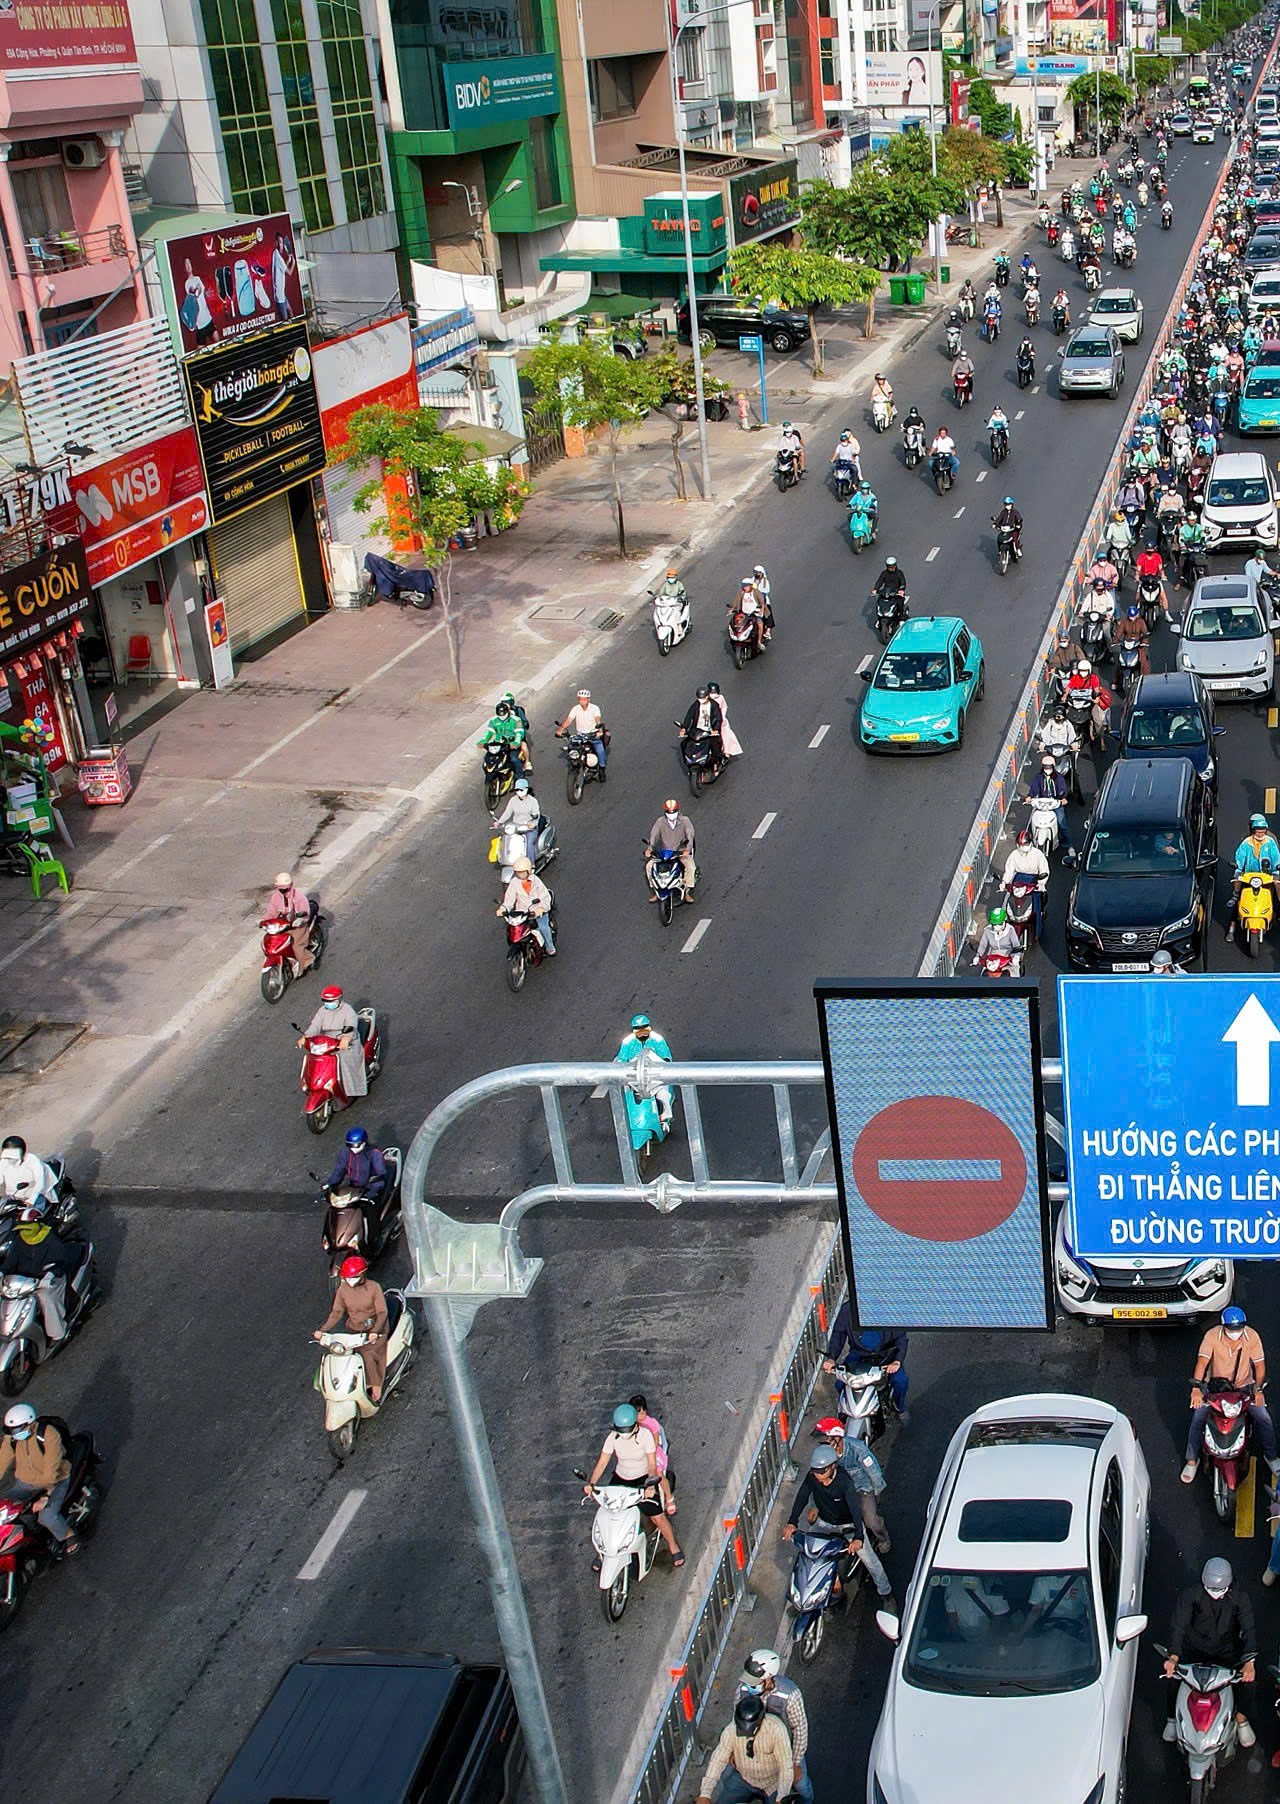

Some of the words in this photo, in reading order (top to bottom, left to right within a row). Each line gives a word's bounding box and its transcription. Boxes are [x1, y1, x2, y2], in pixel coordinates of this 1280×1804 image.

[455, 81, 482, 110] BIDV
[223, 438, 264, 463] PICKLEBALL
[271, 419, 305, 443] FOOTBALL
[25, 470, 73, 519] 79K
[112, 461, 160, 513] MSB
[16, 554, 80, 616] CUỐN
[1082, 1121, 1177, 1157] HƯỚNG
[1185, 1122, 1237, 1157] CÁC
[1098, 1175, 1123, 1200] ĐI
[1130, 1161, 1222, 1201] THẲNG
[1110, 1211, 1203, 1244] ĐƯỜNG
